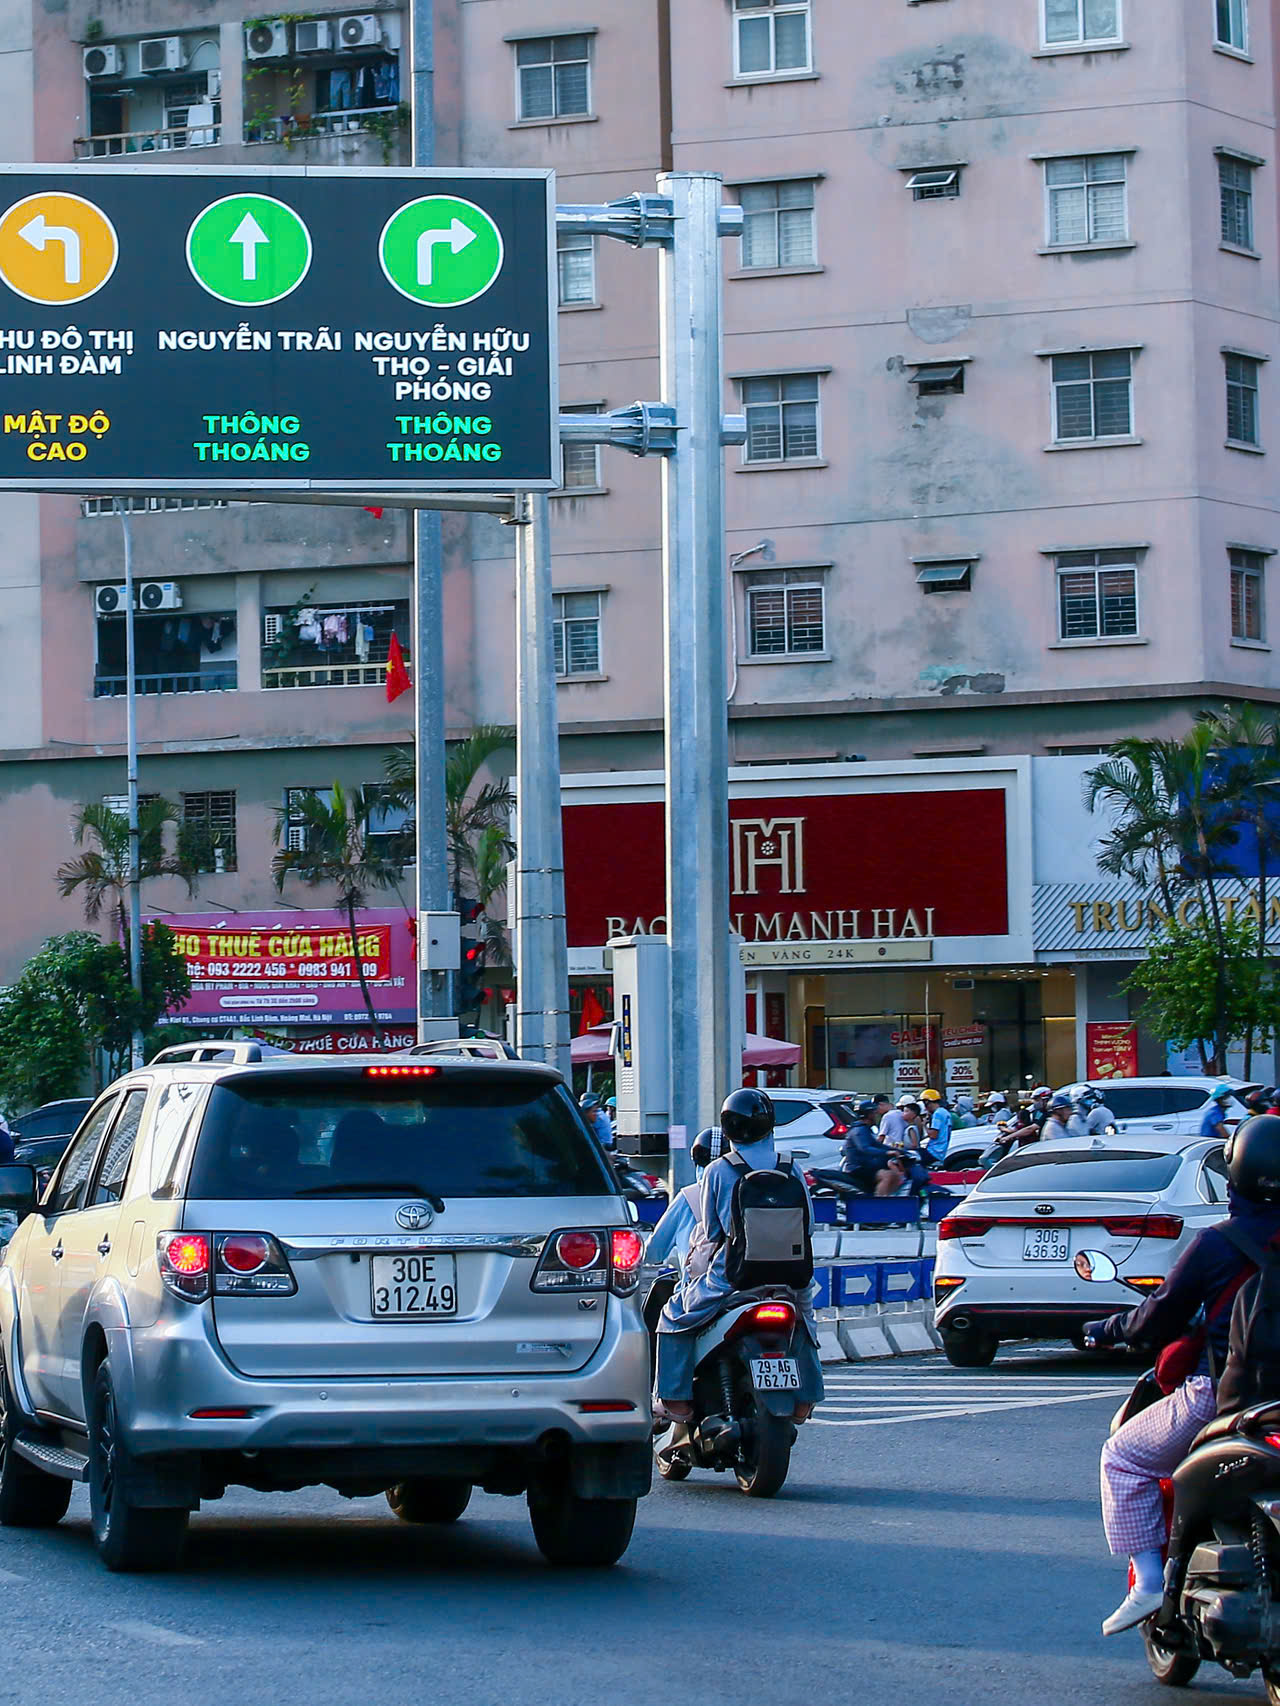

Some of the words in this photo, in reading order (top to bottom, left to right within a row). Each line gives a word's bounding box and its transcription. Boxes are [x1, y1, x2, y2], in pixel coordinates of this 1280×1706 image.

[41, 325, 82, 350] ĐÔ
[88, 330, 134, 355] THỊ
[158, 323, 271, 351] NGUYỄN
[277, 327, 342, 351] TRÃI
[354, 323, 466, 351] NGUYỄN
[473, 327, 530, 352] HỮU
[59, 350, 122, 375] ĐÀM
[372, 357, 430, 380] THỌ
[457, 351, 513, 376] GIẢI
[395, 376, 492, 401] PHÓNG
[3, 409, 62, 439] MẬT
[68, 409, 110, 439] ĐỘ
[202, 410, 300, 434] THÔNG
[395, 411, 492, 435] THÔNG
[27, 442, 87, 461] CAO
[193, 437, 310, 461] THOÁNG
[386, 437, 502, 462] THOÁNG
[171, 934, 200, 957] HO
[207, 931, 261, 957] THUÊ
[268, 930, 312, 957] CỬA
[320, 932, 380, 957] HÀNG
[772, 948, 811, 960] VÀNG
[827, 949, 854, 959] 24K
[207, 962, 229, 976] 093
[232, 962, 261, 976] 2222
[264, 962, 286, 976] 456
[298, 962, 327, 976] 0983
[330, 962, 351, 976] 941
[898, 1066, 921, 1076] 100K
[1035, 1230, 1058, 1243] 30G
[1024, 1245, 1067, 1259] 436.39
[392, 1257, 436, 1282] 30E
[376, 1285, 454, 1313] 312.49
[758, 1360, 791, 1373] 29-AG
[757, 1374, 797, 1387] 762.76
